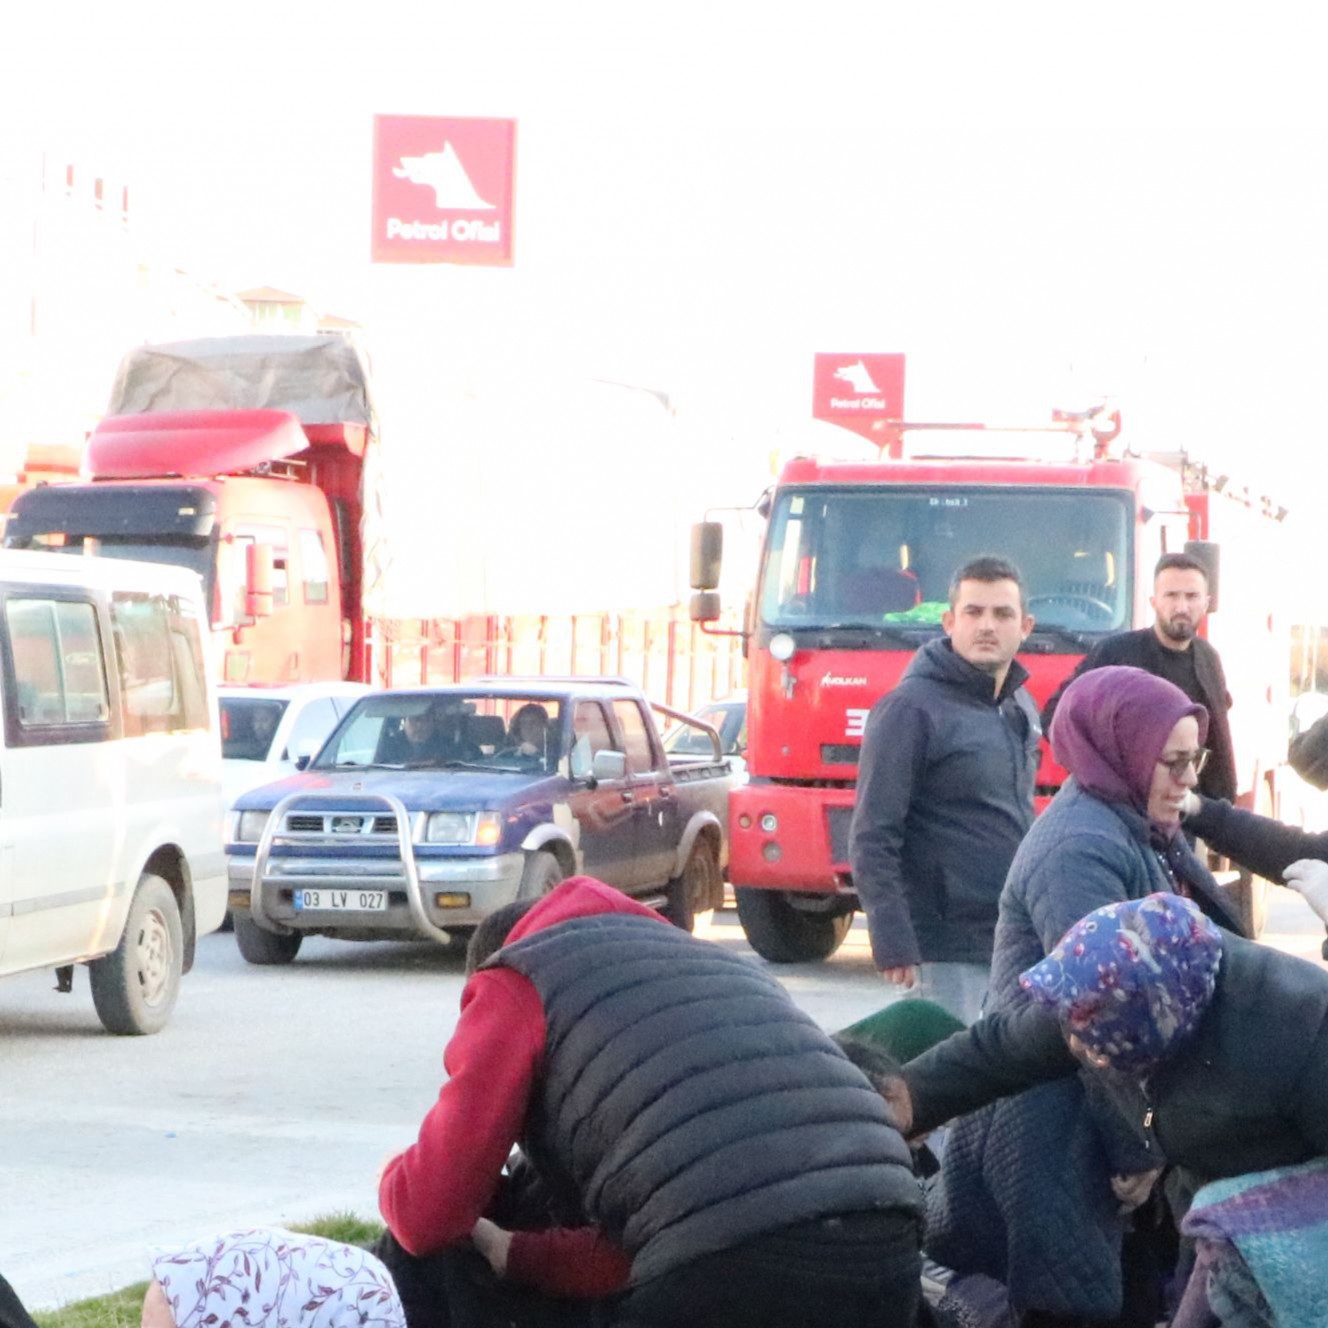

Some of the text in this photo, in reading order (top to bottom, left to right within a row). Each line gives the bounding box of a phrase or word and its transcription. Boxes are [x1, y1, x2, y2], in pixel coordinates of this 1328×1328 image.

[387, 217, 500, 241] Petrol Ofisi
[830, 397, 860, 409] Petrol
[303, 891, 383, 909] 03 LV 027
